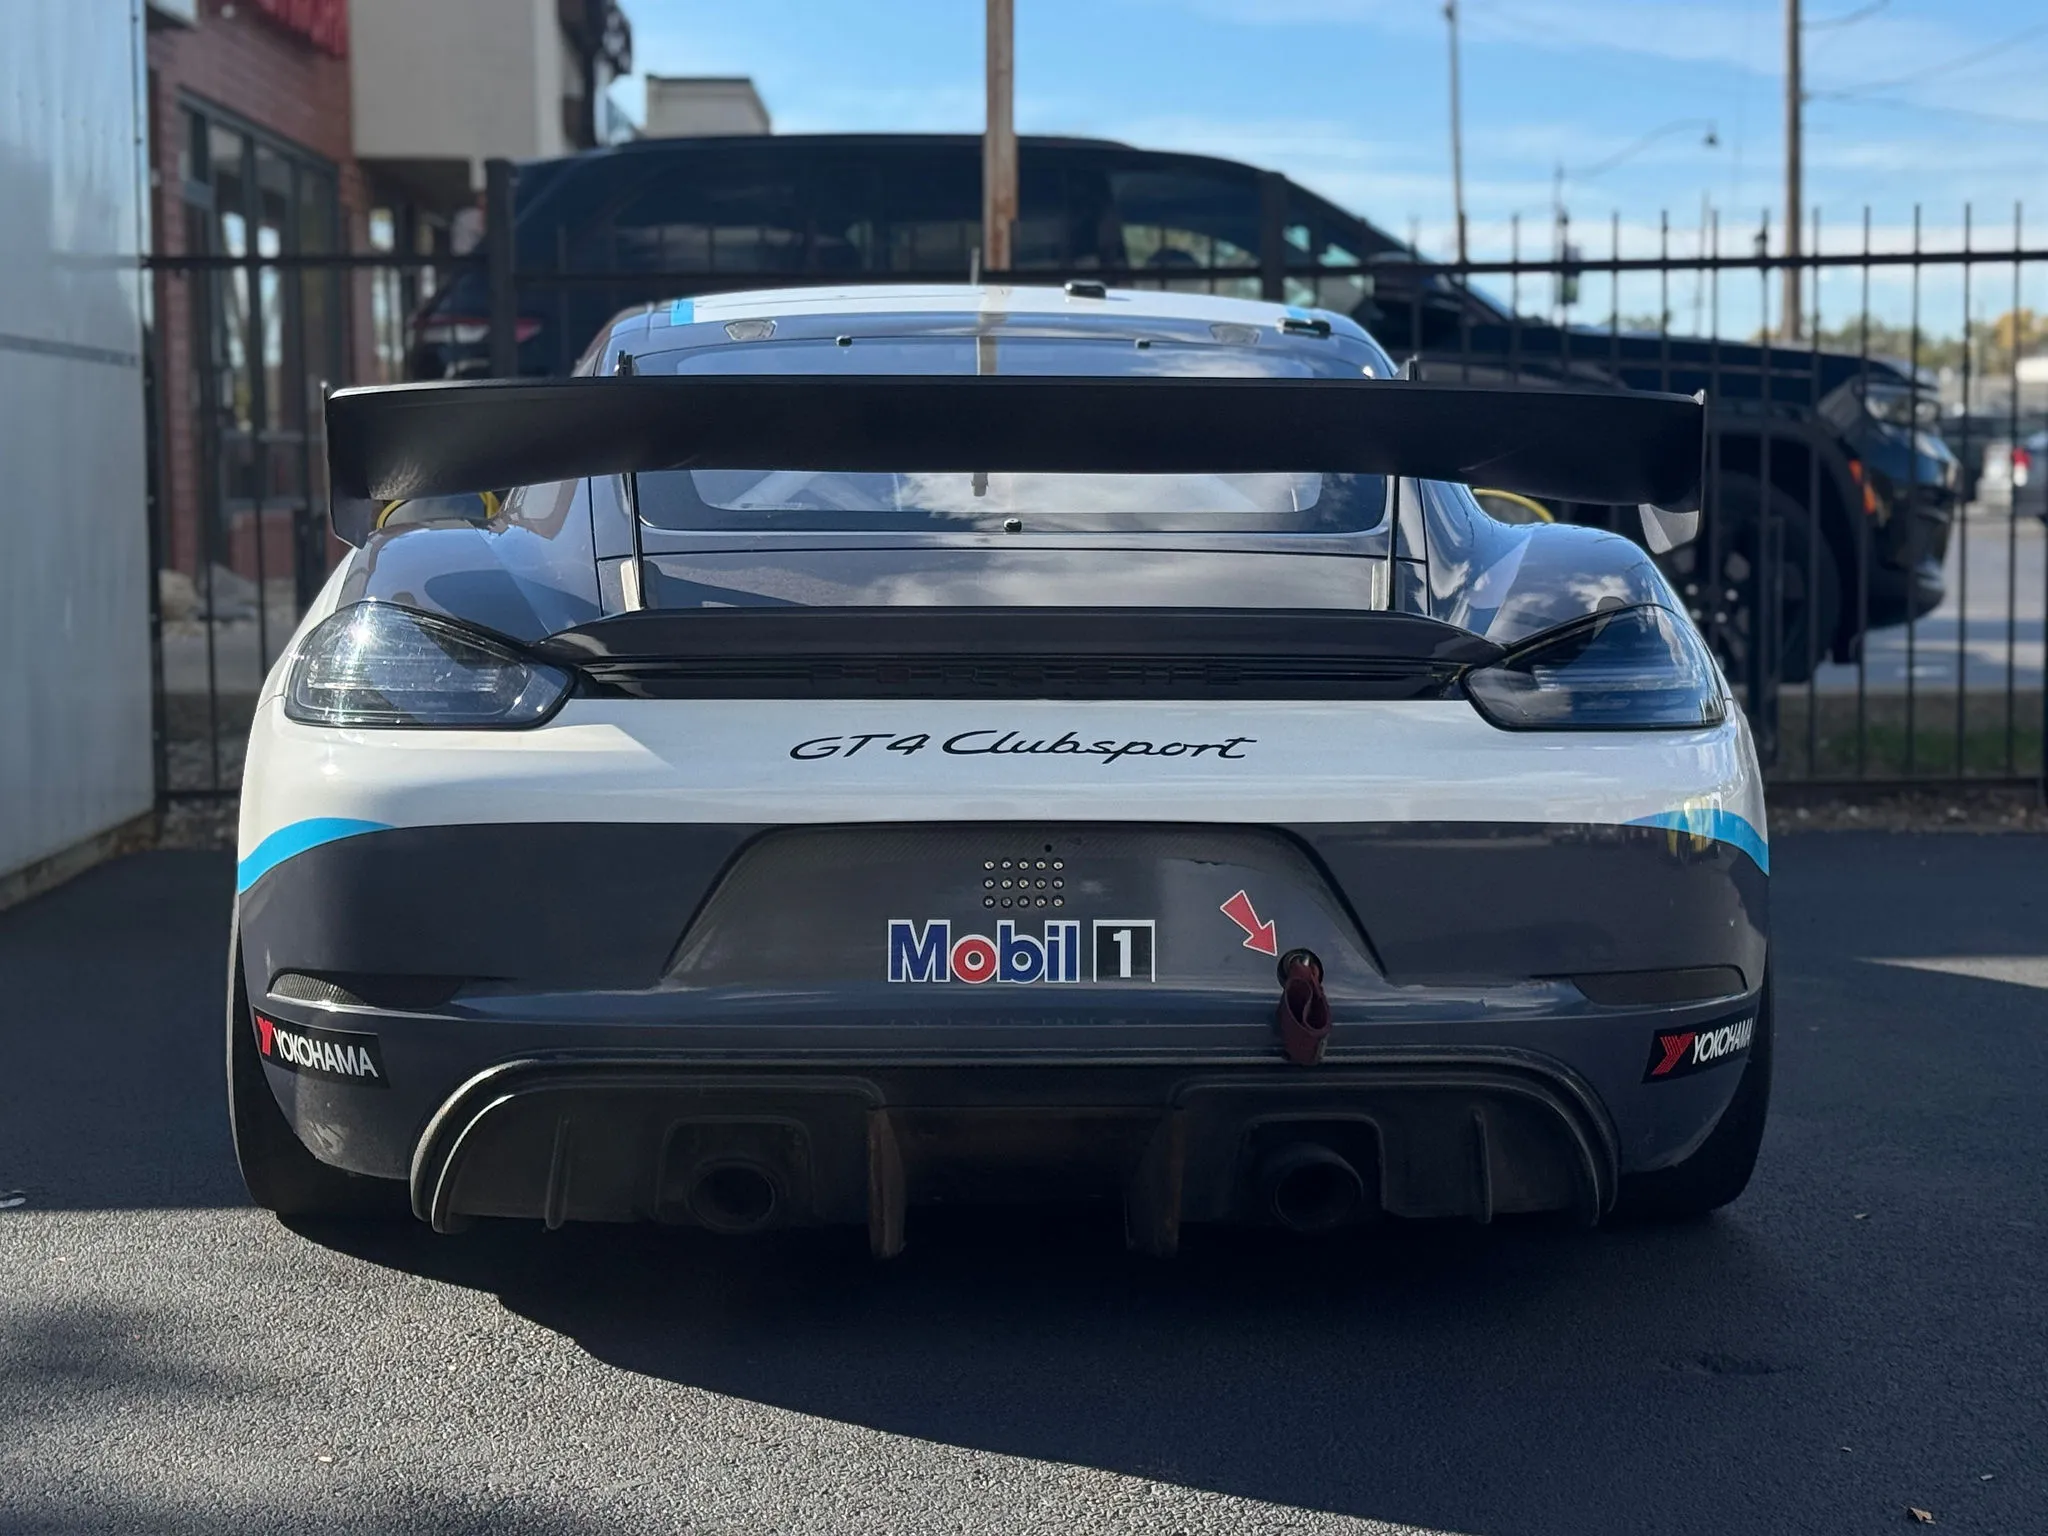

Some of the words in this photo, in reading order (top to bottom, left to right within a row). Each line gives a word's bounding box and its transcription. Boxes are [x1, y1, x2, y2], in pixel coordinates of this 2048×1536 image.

[942, 730, 1258, 765] Clubsport
[888, 919, 1081, 985] Mobil
[1112, 929, 1132, 979] 1
[272, 1027, 379, 1078] YOKOHAMA
